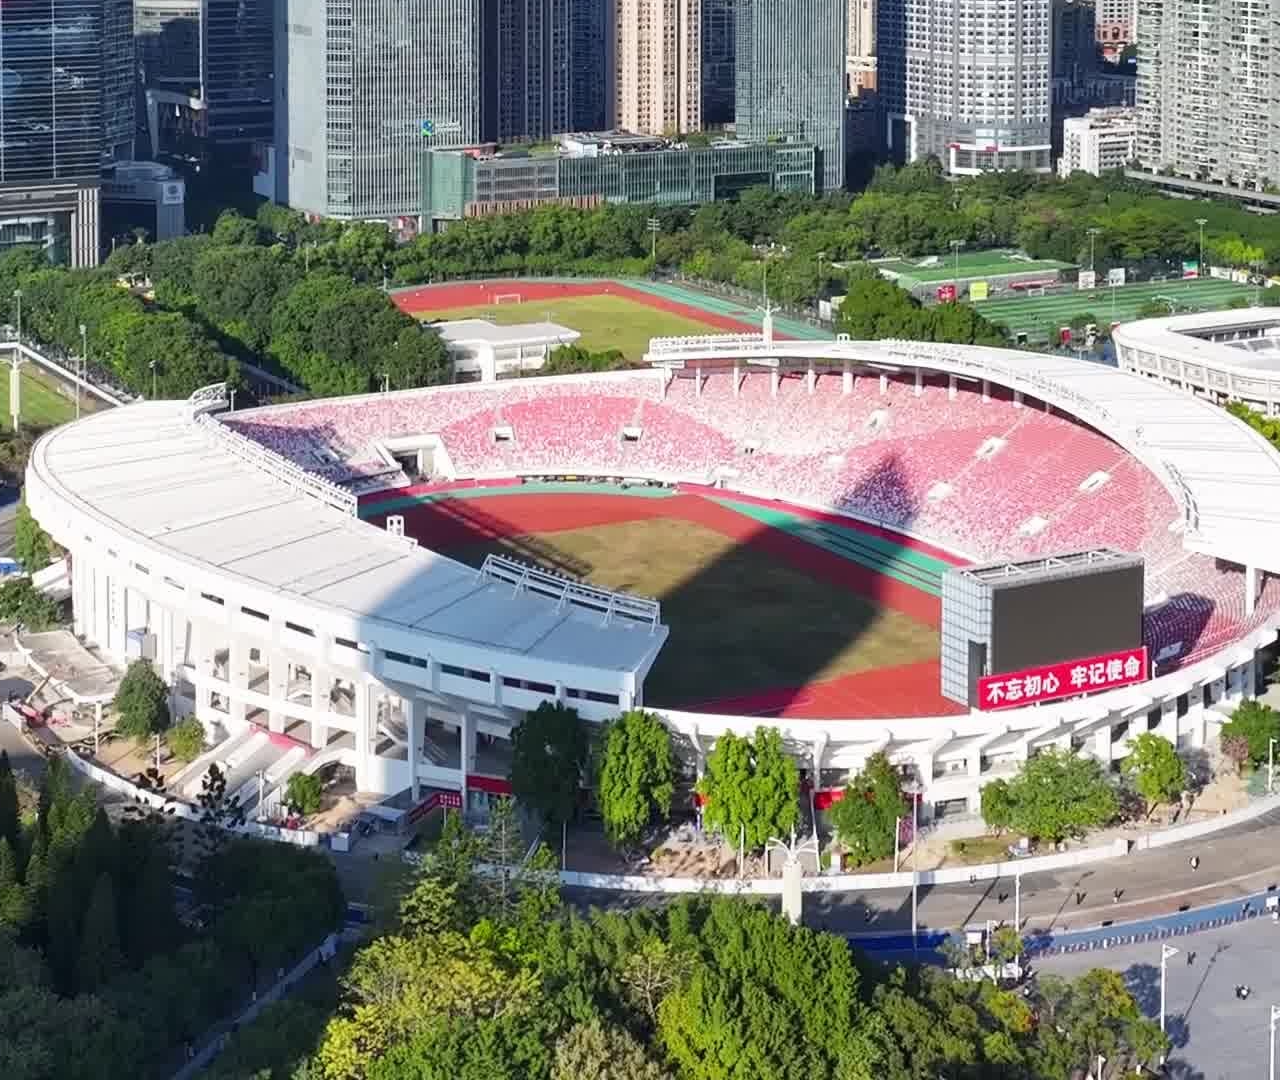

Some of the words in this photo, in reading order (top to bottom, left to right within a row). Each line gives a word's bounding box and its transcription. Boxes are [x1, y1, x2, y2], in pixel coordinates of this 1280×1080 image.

[986, 672, 1060, 705] 不忘初心
[1070, 655, 1141, 688] 牢记使命
